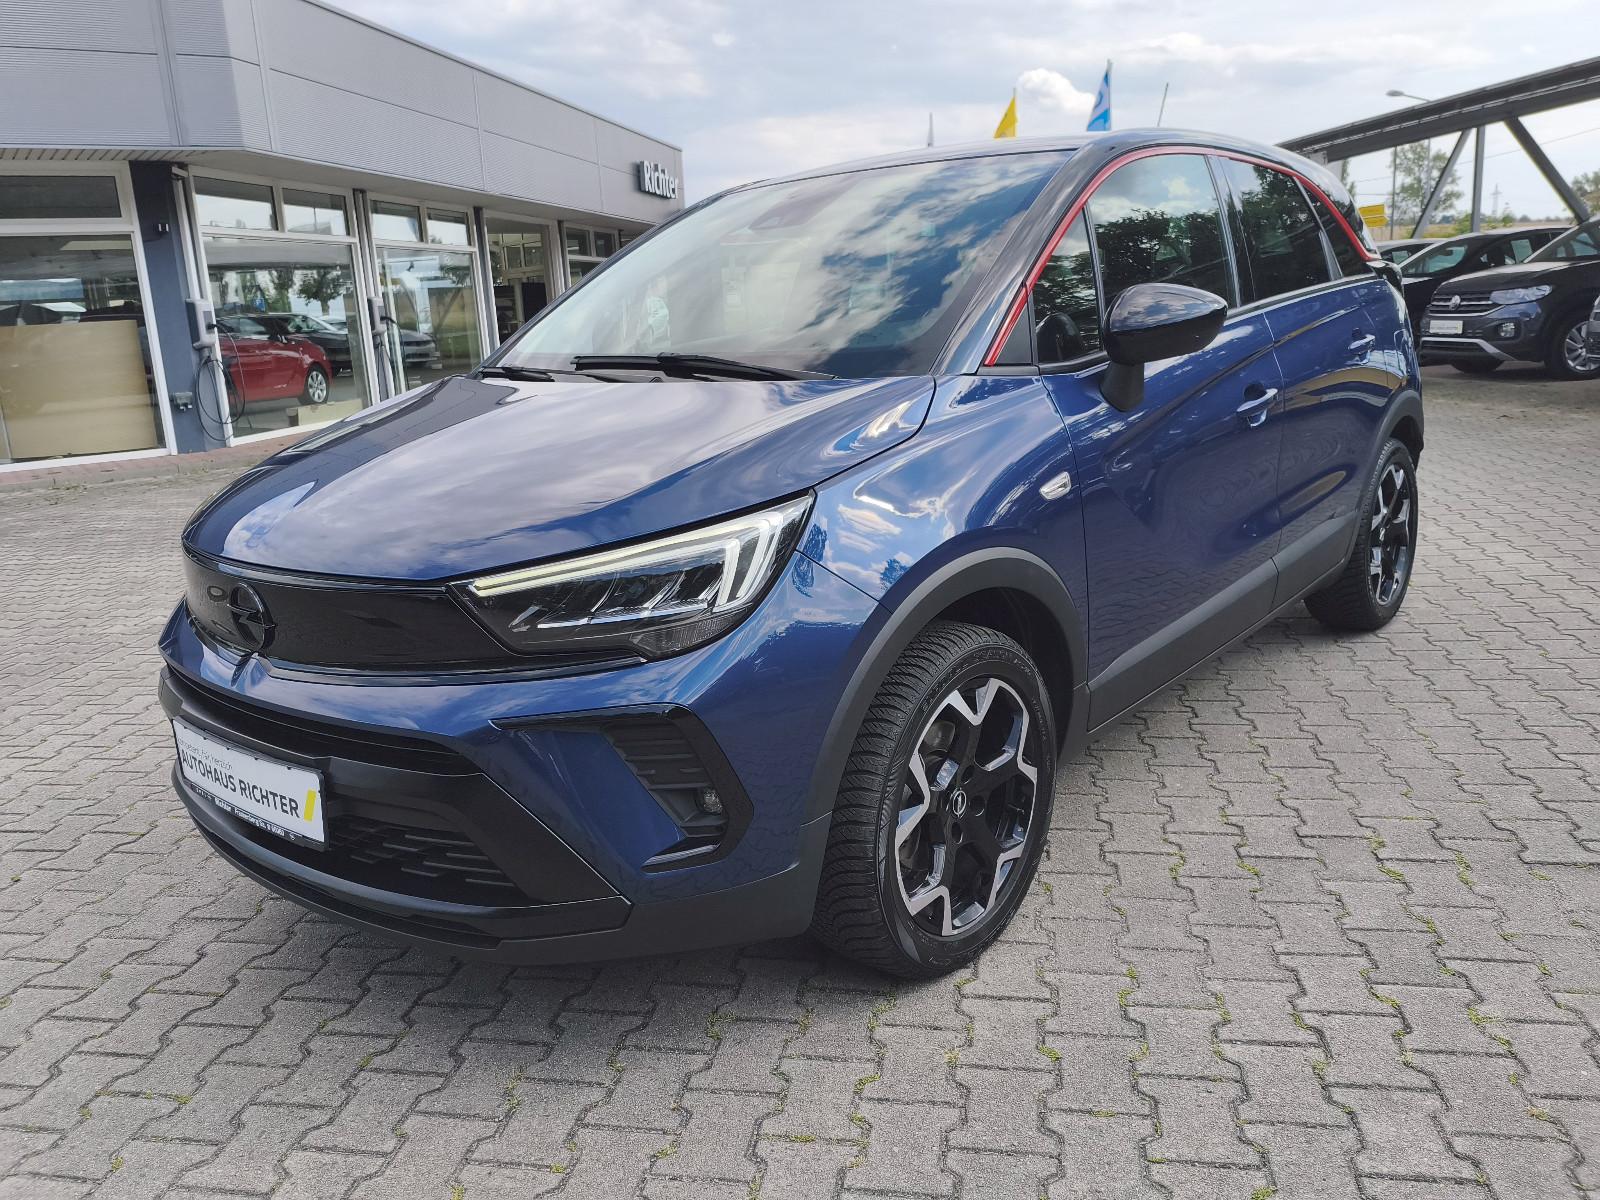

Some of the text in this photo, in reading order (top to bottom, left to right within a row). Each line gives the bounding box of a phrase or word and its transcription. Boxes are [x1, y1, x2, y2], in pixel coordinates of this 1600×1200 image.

[643, 160, 679, 199] Richter
[181, 749, 237, 793] AUTOHAUS
[238, 779, 300, 818] RICHTER
